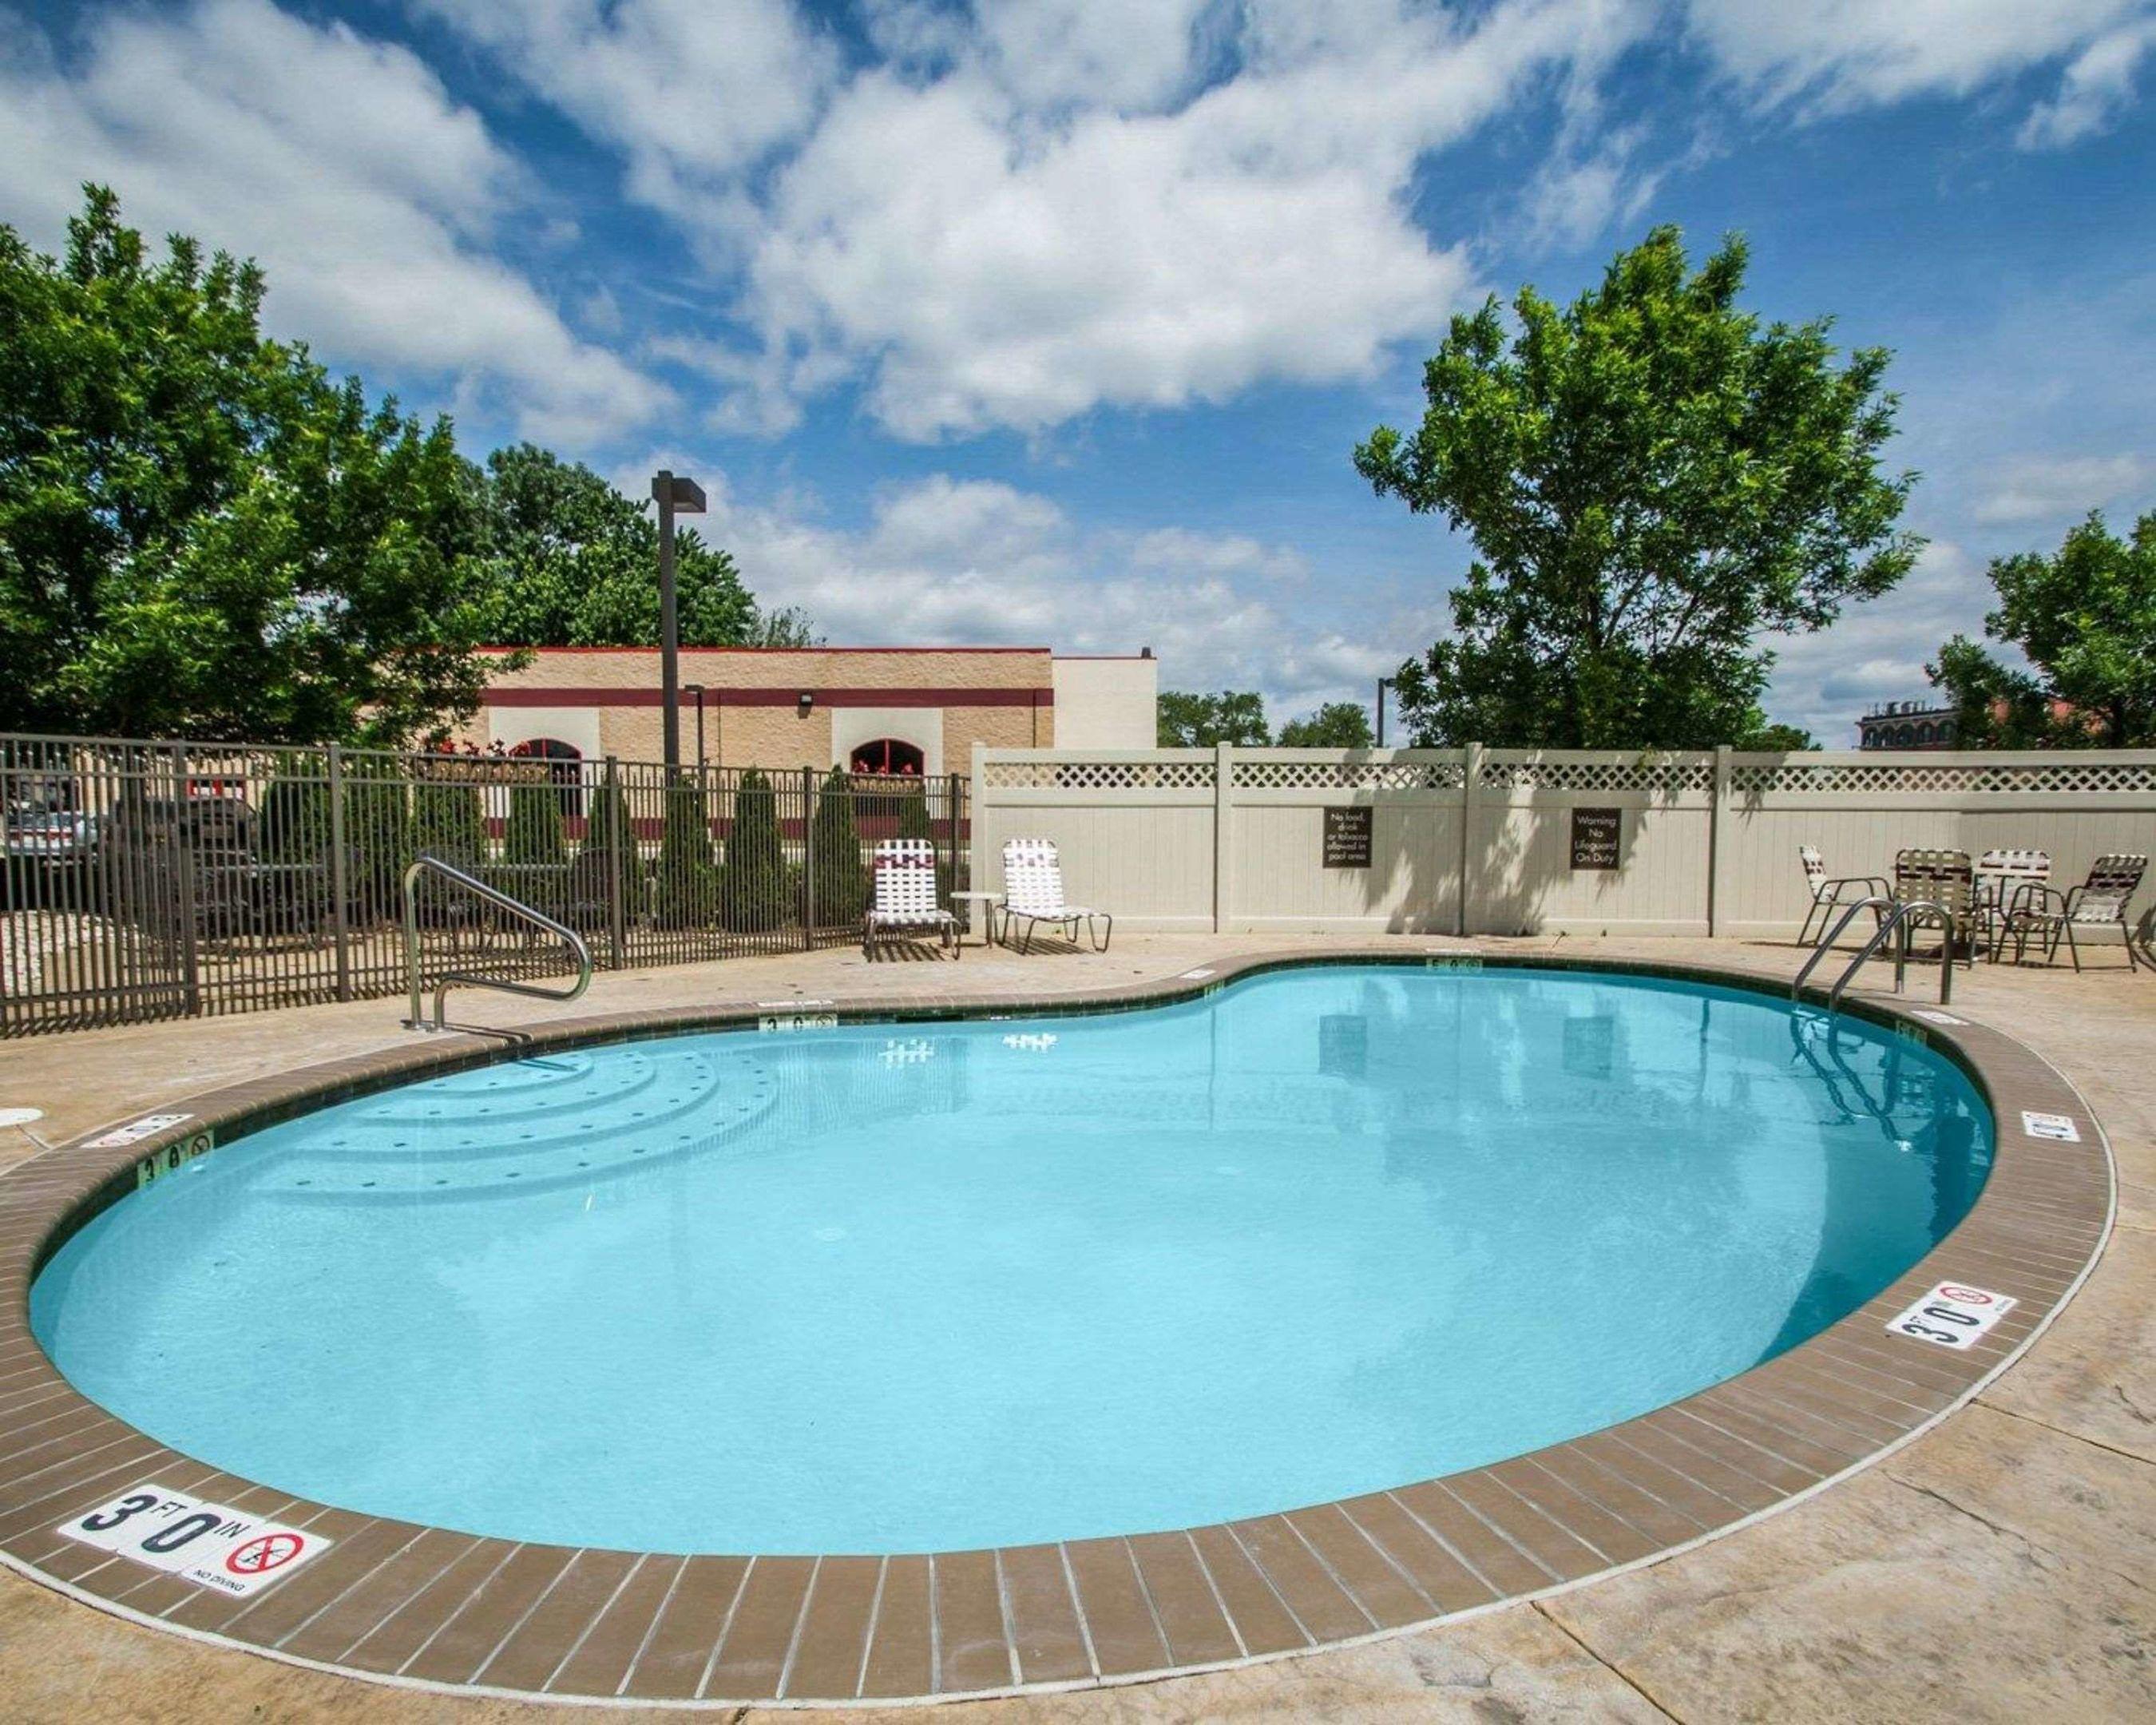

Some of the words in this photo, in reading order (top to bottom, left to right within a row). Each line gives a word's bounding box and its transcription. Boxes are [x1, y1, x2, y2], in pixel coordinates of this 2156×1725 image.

[1576, 815, 1616, 827] Warning
[1588, 829, 1603, 838] No
[1575, 839, 1616, 852] Lifeguard
[1575, 852, 1590, 862] On
[1593, 852, 1615, 863] Duty
[1923, 1307, 1980, 1326] 0
[1901, 1323, 1960, 1343] 3
[81, 1493, 159, 1532] 3
[151, 1501, 188, 1518] FT
[141, 1513, 222, 1553] 0
[212, 1520, 252, 1539] IN
[193, 1569, 212, 1578] NO
[209, 1576, 246, 1592] DIVING
